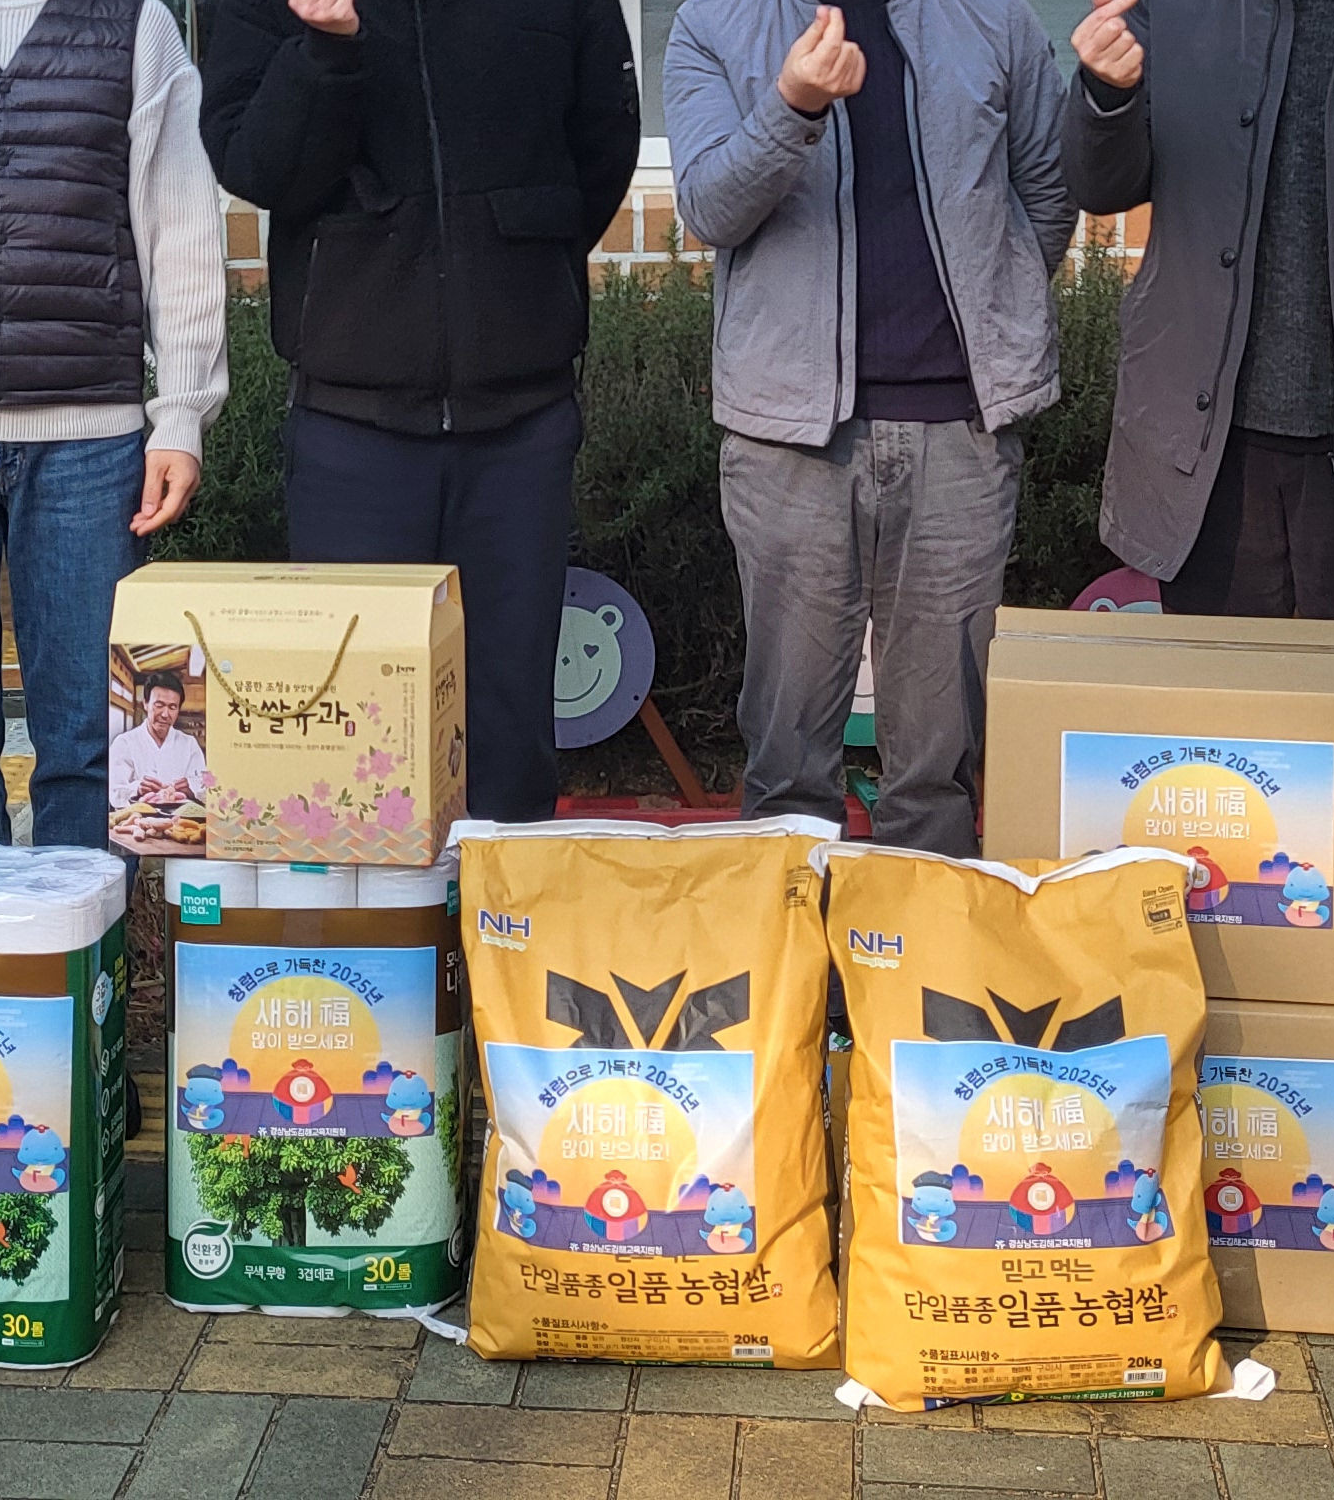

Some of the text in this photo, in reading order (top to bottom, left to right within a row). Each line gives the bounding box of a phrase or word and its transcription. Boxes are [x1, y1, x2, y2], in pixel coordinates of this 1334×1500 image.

[234, 681, 262, 693] 달콤한
[227, 698, 350, 737] 찹쌀유과
[1120, 746, 1281, 797] 청렴으로 가득찬 2025년
[1148, 785, 1247, 818] 새해 福
[1145, 819, 1250, 841] 많이 받으세요!
[183, 895, 217, 906] mona
[479, 910, 531, 938] NH
[849, 928, 903, 955] NH
[228, 958, 385, 1007] 청렴으로 가득찬 2025년
[254, 996, 350, 1029] 새해 福
[251, 1032, 354, 1051] 많이 받으세요!
[538, 1059, 700, 1114] 청렴으로 가득찬 2025년
[954, 1055, 1117, 1101] 청렴으로 가득찬 2025년
[1209, 1065, 1314, 1118] 가득찬 2025년
[567, 1102, 666, 1136] 새해 福
[986, 1093, 1085, 1131] 새해 福
[1247, 1107, 1278, 1138] 福
[562, 1139, 670, 1162] 많이 받으세요!
[982, 1131, 1093, 1153] 많이 받으세요!
[1214, 1142, 1283, 1162] 받으세요!
[191, 1243, 222, 1257] 친환경
[1001, 1258, 1096, 1283] 믿고 먹는
[520, 1263, 606, 1298] 단일품종
[607, 1269, 672, 1305] 일품
[675, 1263, 772, 1306] 농협쌀
[904, 1284, 1169, 1329] 단일품종 일품 농협쌀
[541, 1317, 601, 1331] 품질표시사항
[644, 1336, 671, 1345] 구미시
[733, 1334, 769, 1346] 20kg
[929, 1349, 991, 1362] 품질표시사항
[1035, 1364, 1063, 1373] 구미시
[1127, 1357, 1163, 1369] 20kg
